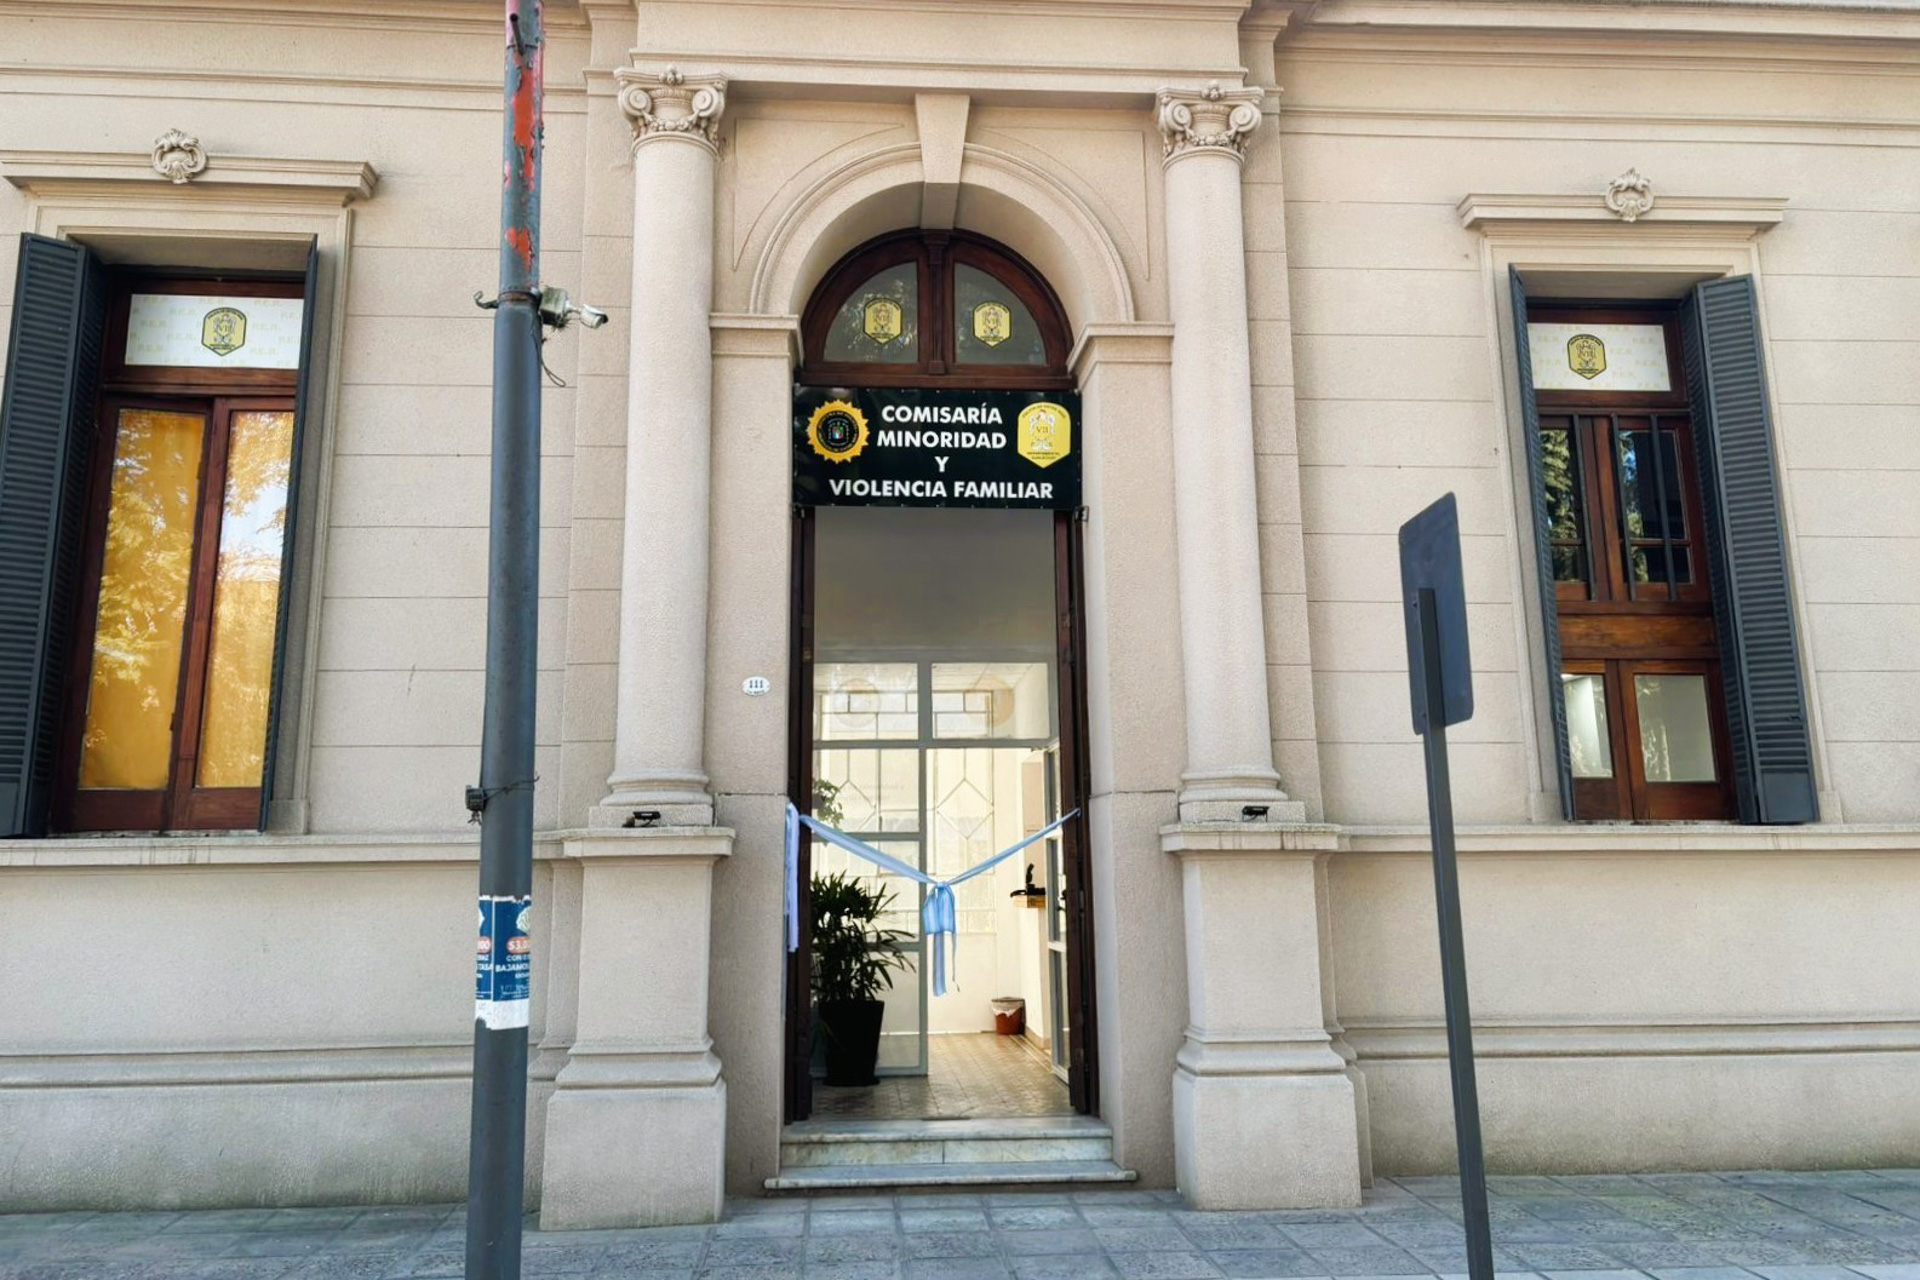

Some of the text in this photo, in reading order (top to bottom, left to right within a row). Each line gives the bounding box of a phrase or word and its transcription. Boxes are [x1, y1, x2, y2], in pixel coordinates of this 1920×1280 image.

[881, 402, 1003, 425] COMISARÍA
[876, 430, 1007, 450] MINORIDAD
[934, 455, 950, 473] Y
[829, 479, 1054, 499] VIOLENCIA FAMILIAR
[749, 679, 763, 689] 111
